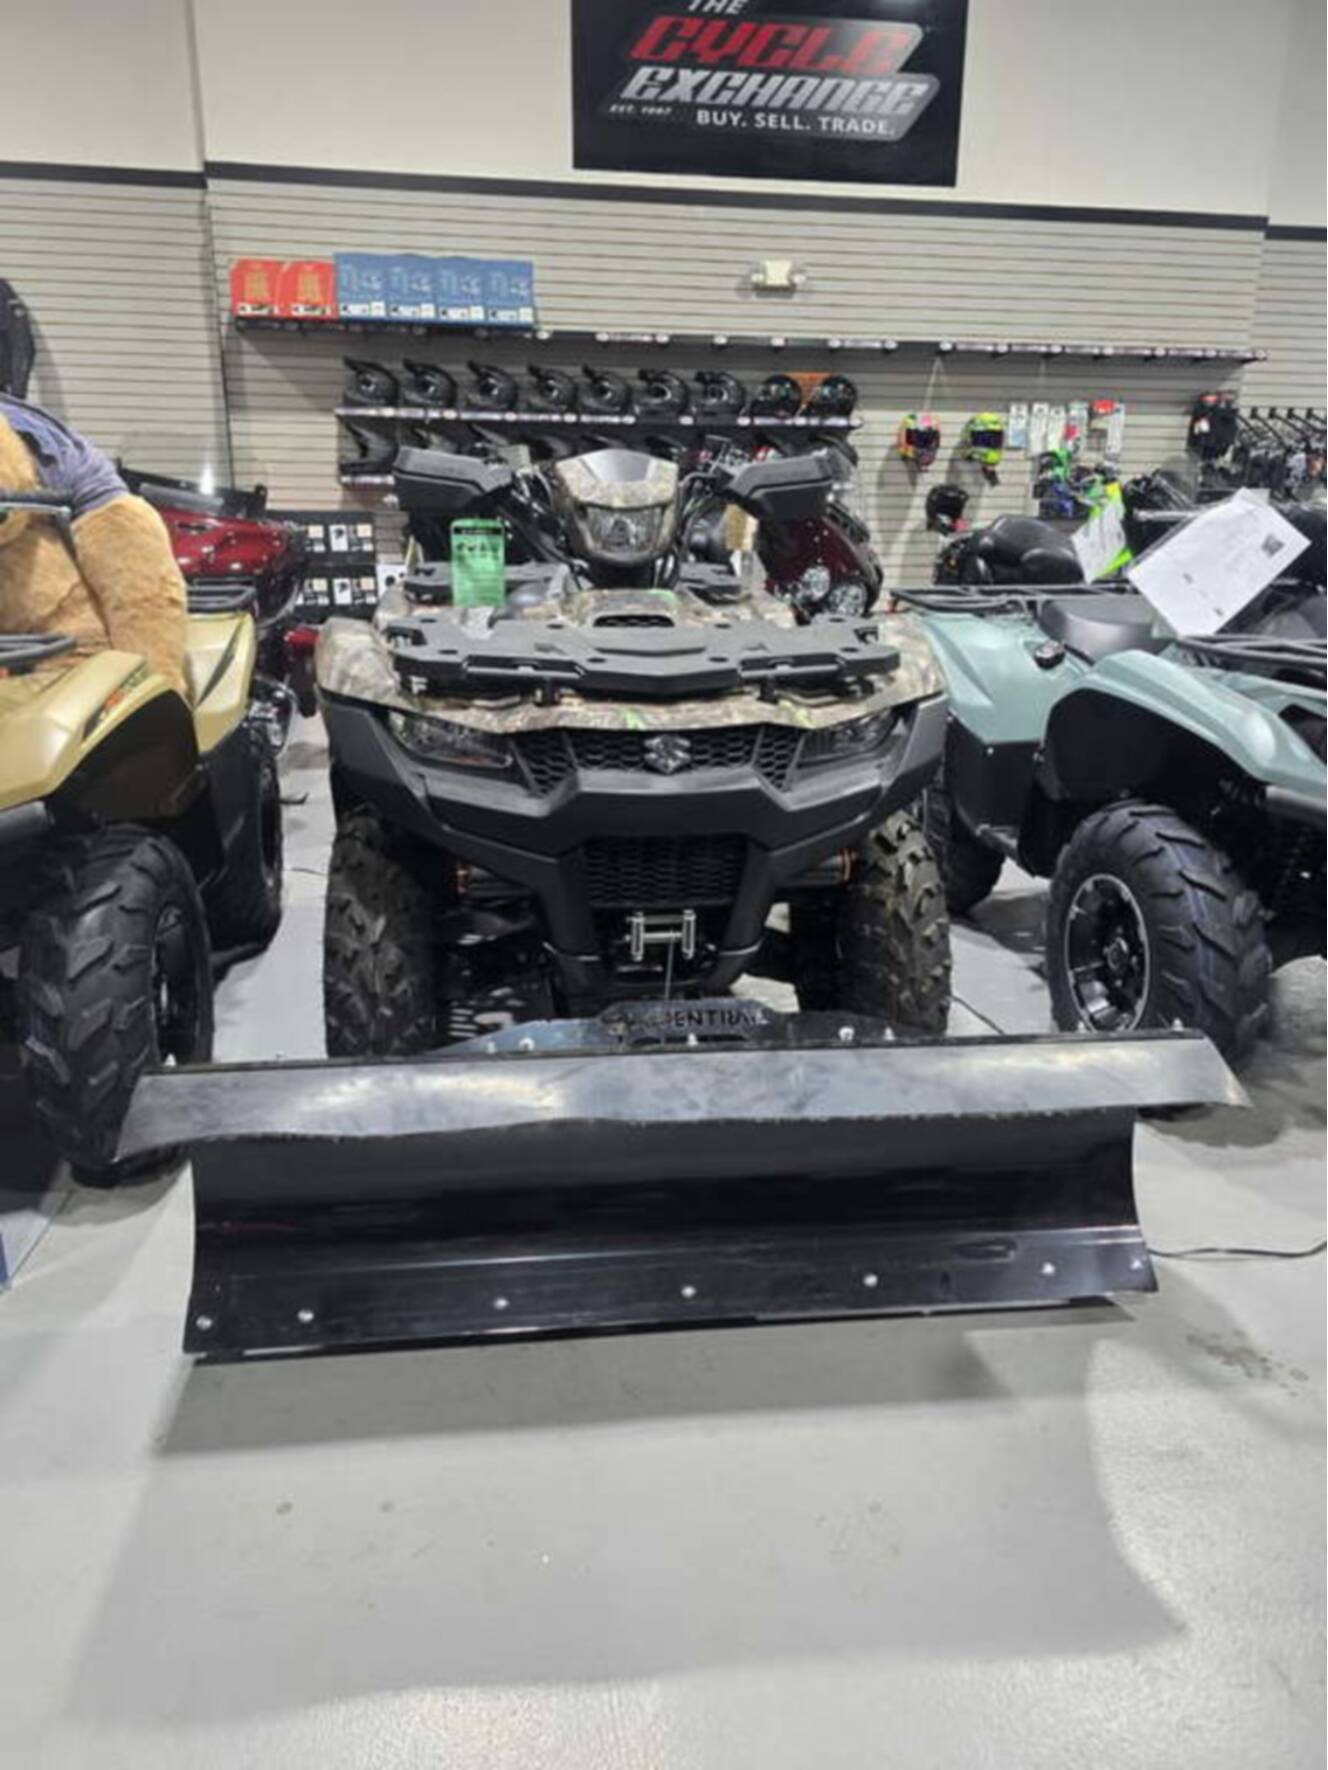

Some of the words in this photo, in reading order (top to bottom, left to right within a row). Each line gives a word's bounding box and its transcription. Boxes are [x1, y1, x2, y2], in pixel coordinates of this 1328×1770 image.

[688, 0, 748, 15] THE
[629, 16, 909, 77] CYCLE
[619, 66, 929, 115] EXCHANGE
[696, 109, 748, 128] BUY.
[754, 112, 812, 131] SELL.
[818, 115, 896, 137] TRADE.
